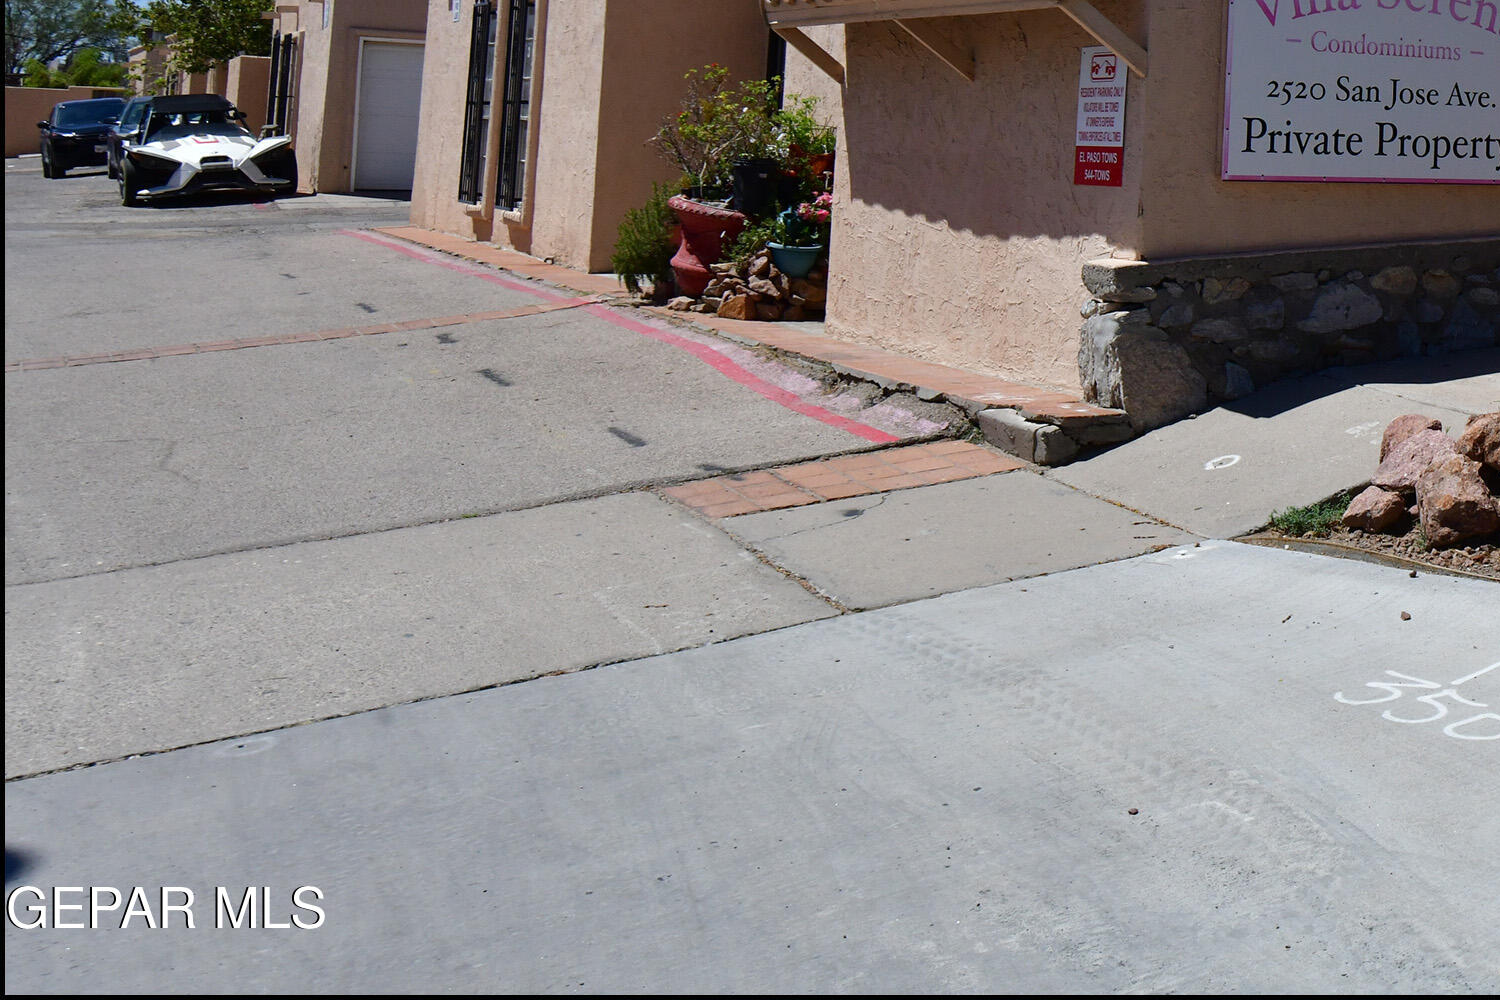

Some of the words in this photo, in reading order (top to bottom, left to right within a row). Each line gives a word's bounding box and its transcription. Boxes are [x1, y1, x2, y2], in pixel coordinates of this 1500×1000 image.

[1311, 30, 1462, 62] Condominiums
[1266, 80, 1326, 106] 2520
[1335, 75, 1381, 103] San
[1384, 78, 1440, 111] Jose
[1445, 81, 1497, 109] Ave.
[1241, 116, 1363, 157] Private
[1079, 152, 1086, 162] EL
[1087, 152, 1100, 163] PASO
[1102, 152, 1118, 164] TOWS
[1084, 169, 1111, 181] 544-TOWS
